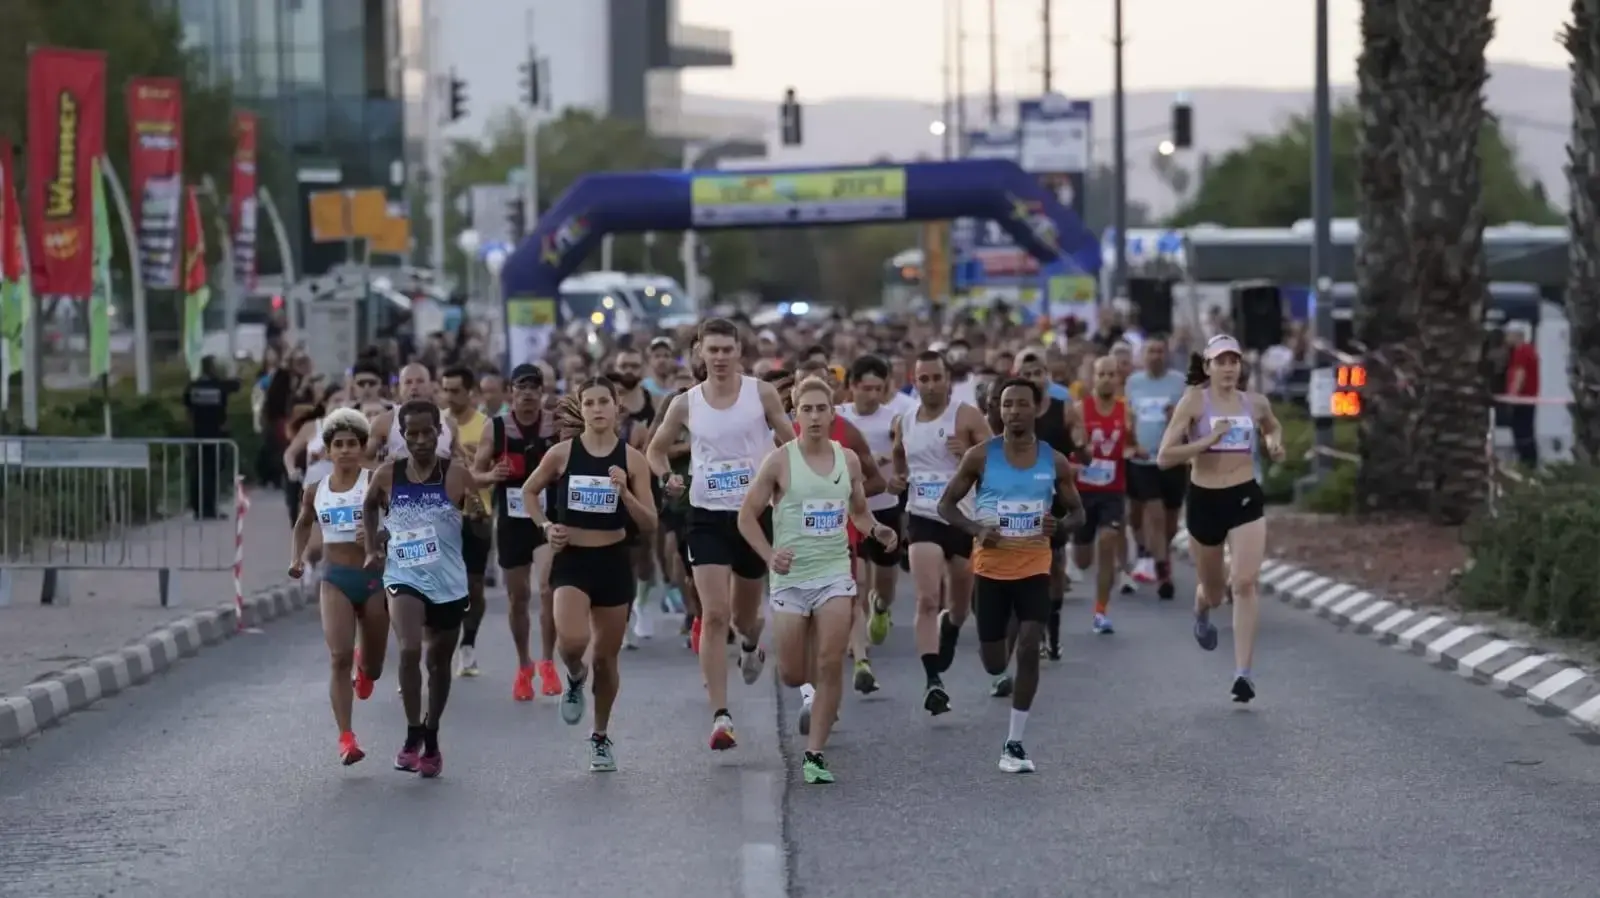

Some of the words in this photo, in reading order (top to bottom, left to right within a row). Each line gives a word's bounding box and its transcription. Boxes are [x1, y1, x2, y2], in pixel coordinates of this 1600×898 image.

[582, 491, 605, 505] 1507
[336, 510, 346, 523] 2
[404, 542, 427, 559] 1298
